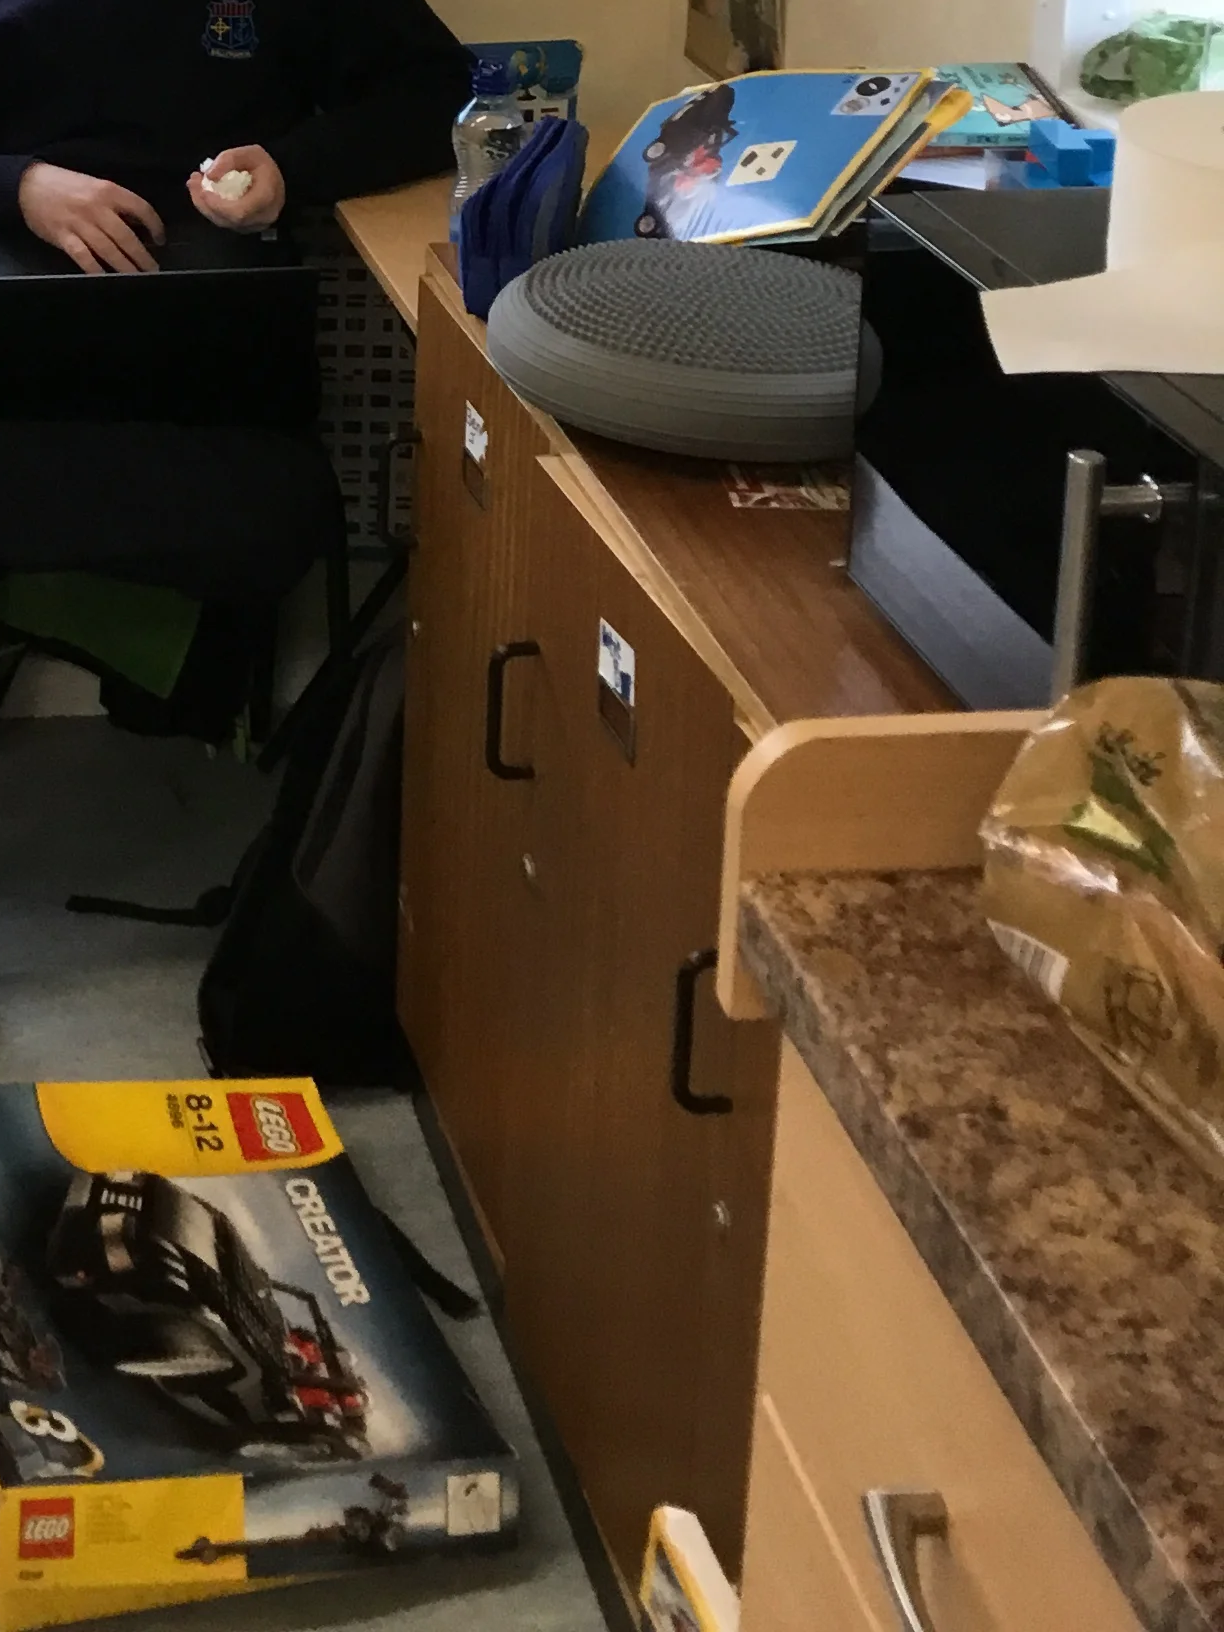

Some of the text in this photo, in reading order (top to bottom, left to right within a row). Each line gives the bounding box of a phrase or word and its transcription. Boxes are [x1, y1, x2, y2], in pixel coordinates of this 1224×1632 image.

[185, 1093, 225, 1152] 8-12
[253, 1097, 298, 1154] LEGO
[285, 1177, 371, 1308] CREATOR
[23, 1515, 70, 1542] LEGO
